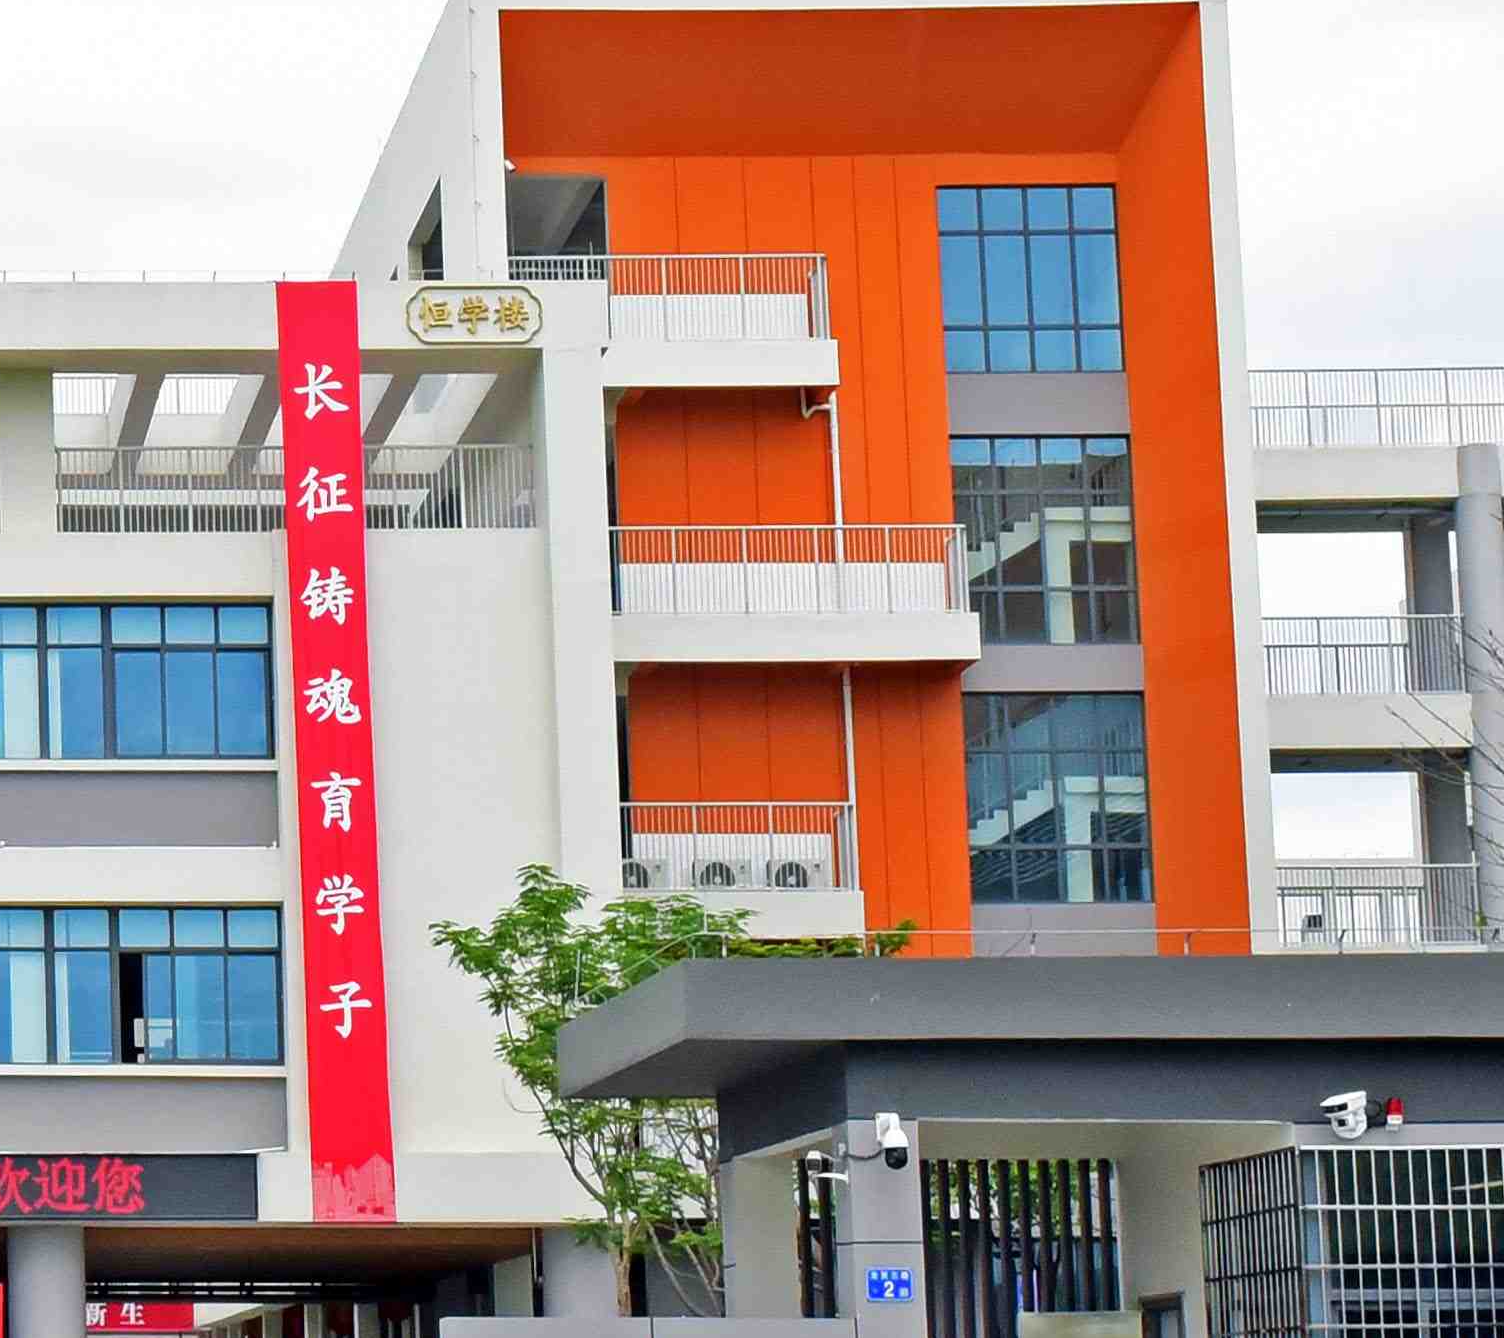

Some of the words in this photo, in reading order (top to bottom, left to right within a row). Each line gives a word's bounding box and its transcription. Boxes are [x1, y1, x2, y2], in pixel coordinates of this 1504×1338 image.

[419, 294, 529, 334] 恒学楼
[293, 363, 373, 1040] 长征铸魂育学子
